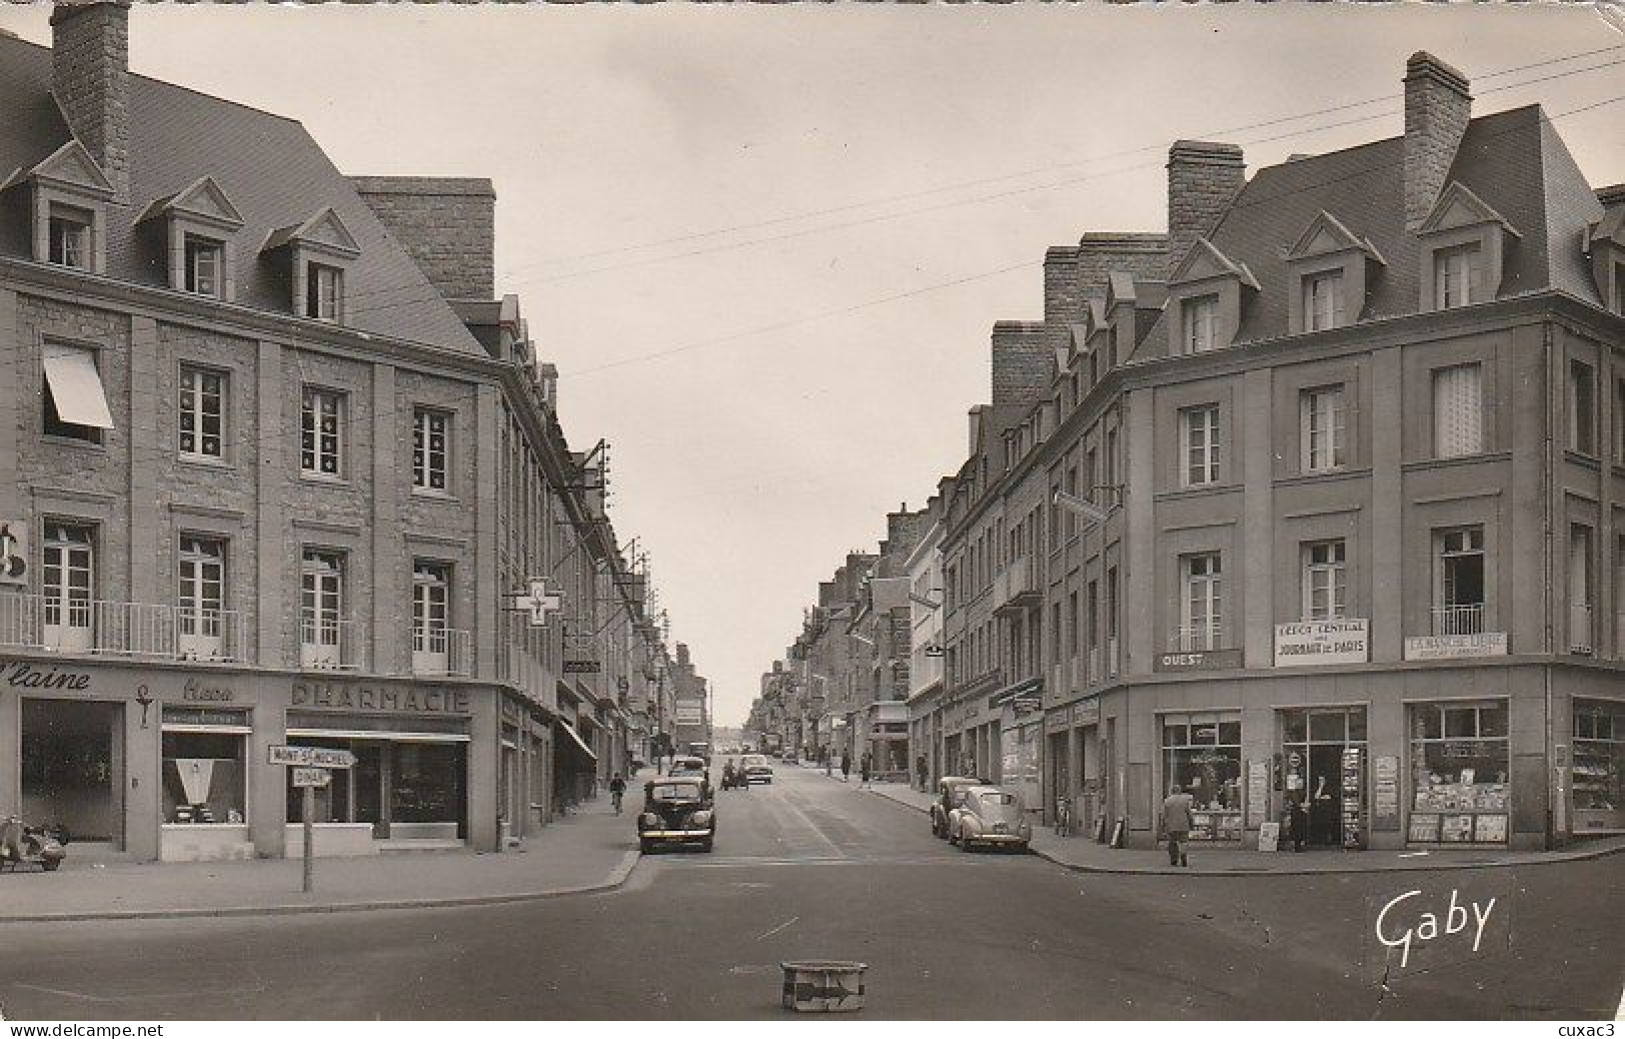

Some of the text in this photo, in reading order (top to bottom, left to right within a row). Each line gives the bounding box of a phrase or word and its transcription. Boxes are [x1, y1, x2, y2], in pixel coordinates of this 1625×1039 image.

[1334, 640, 1364, 653] PARIS
[1163, 654, 1204, 666] OUEST
[291, 683, 469, 713] PHARMACIE
